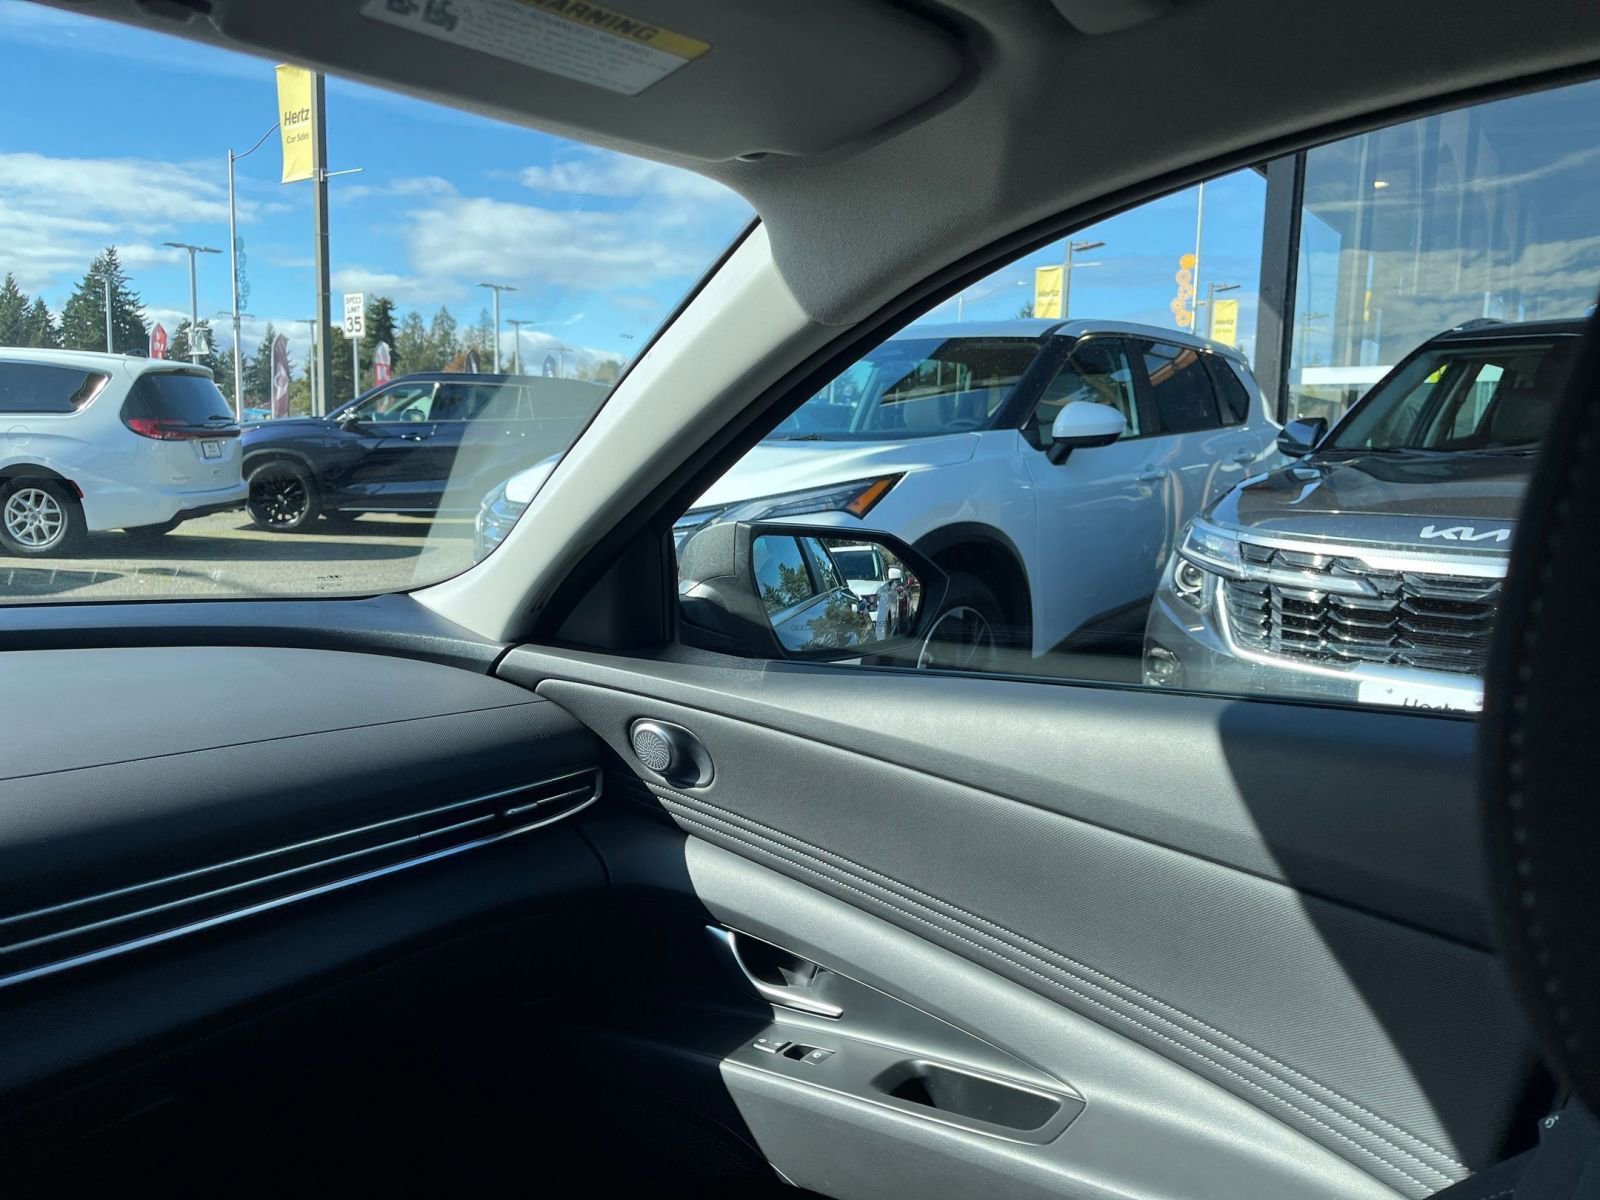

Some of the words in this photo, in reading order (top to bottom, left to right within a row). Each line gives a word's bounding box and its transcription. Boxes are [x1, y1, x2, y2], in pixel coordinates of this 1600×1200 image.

[535, 0, 659, 40] ARNING
[284, 108, 310, 126] Hertz
[346, 316, 362, 332] 35
